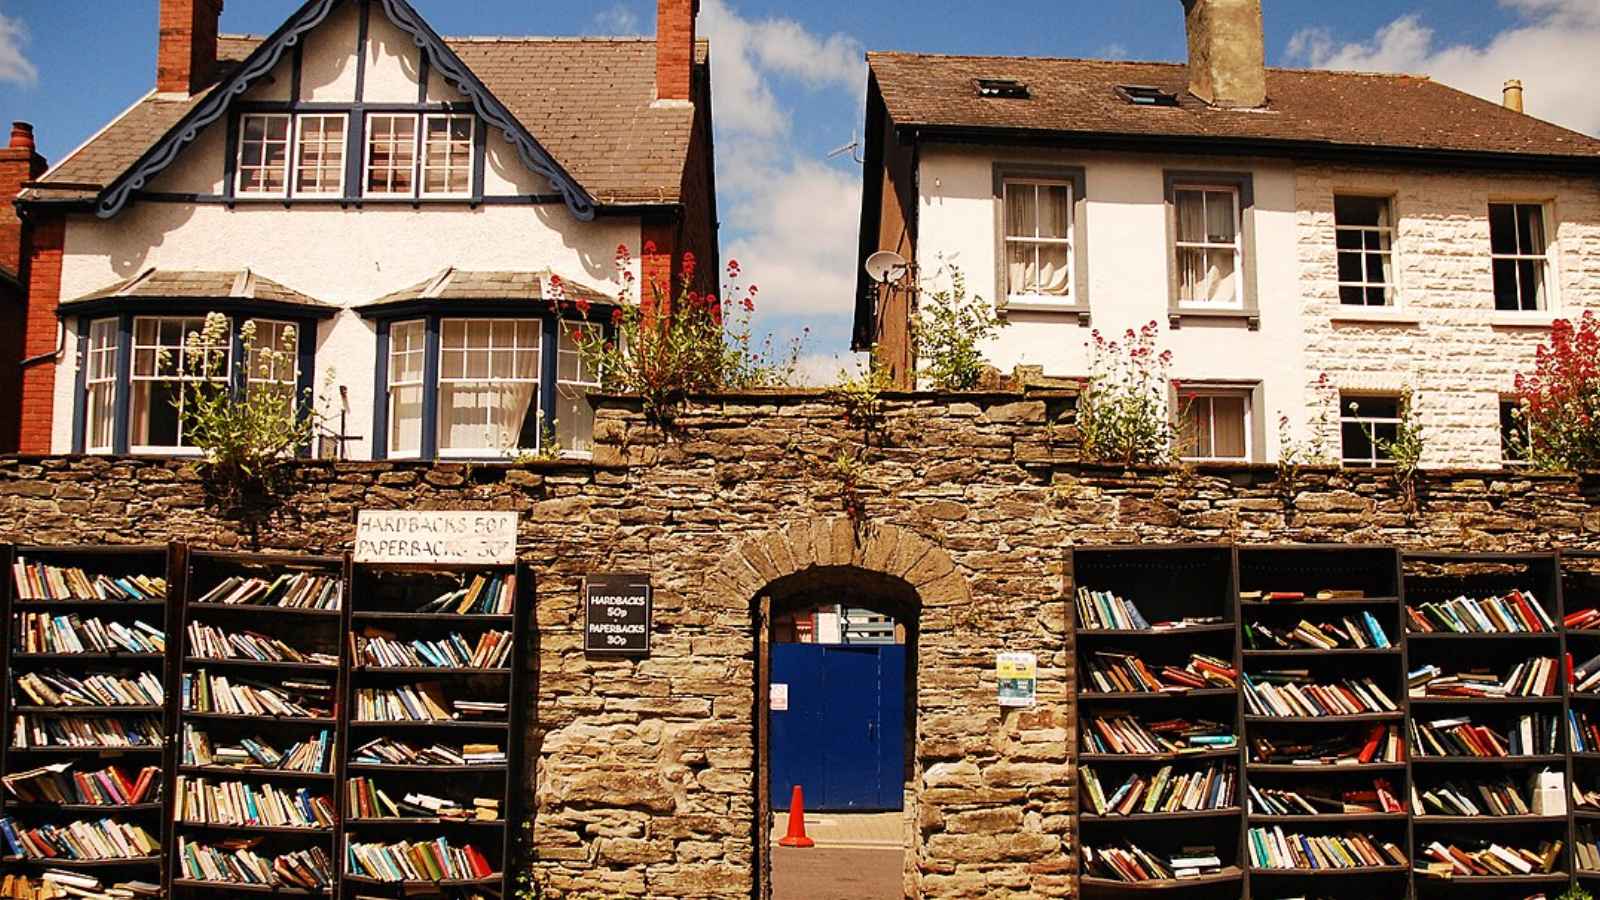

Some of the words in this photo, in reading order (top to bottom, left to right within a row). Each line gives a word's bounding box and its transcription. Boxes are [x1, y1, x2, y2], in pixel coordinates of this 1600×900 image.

[360, 517, 468, 533] HARDBACKS
[590, 596, 646, 606] HARDBACKS
[607, 606, 628, 618] 50p
[589, 624, 646, 633] PAPERBACKS
